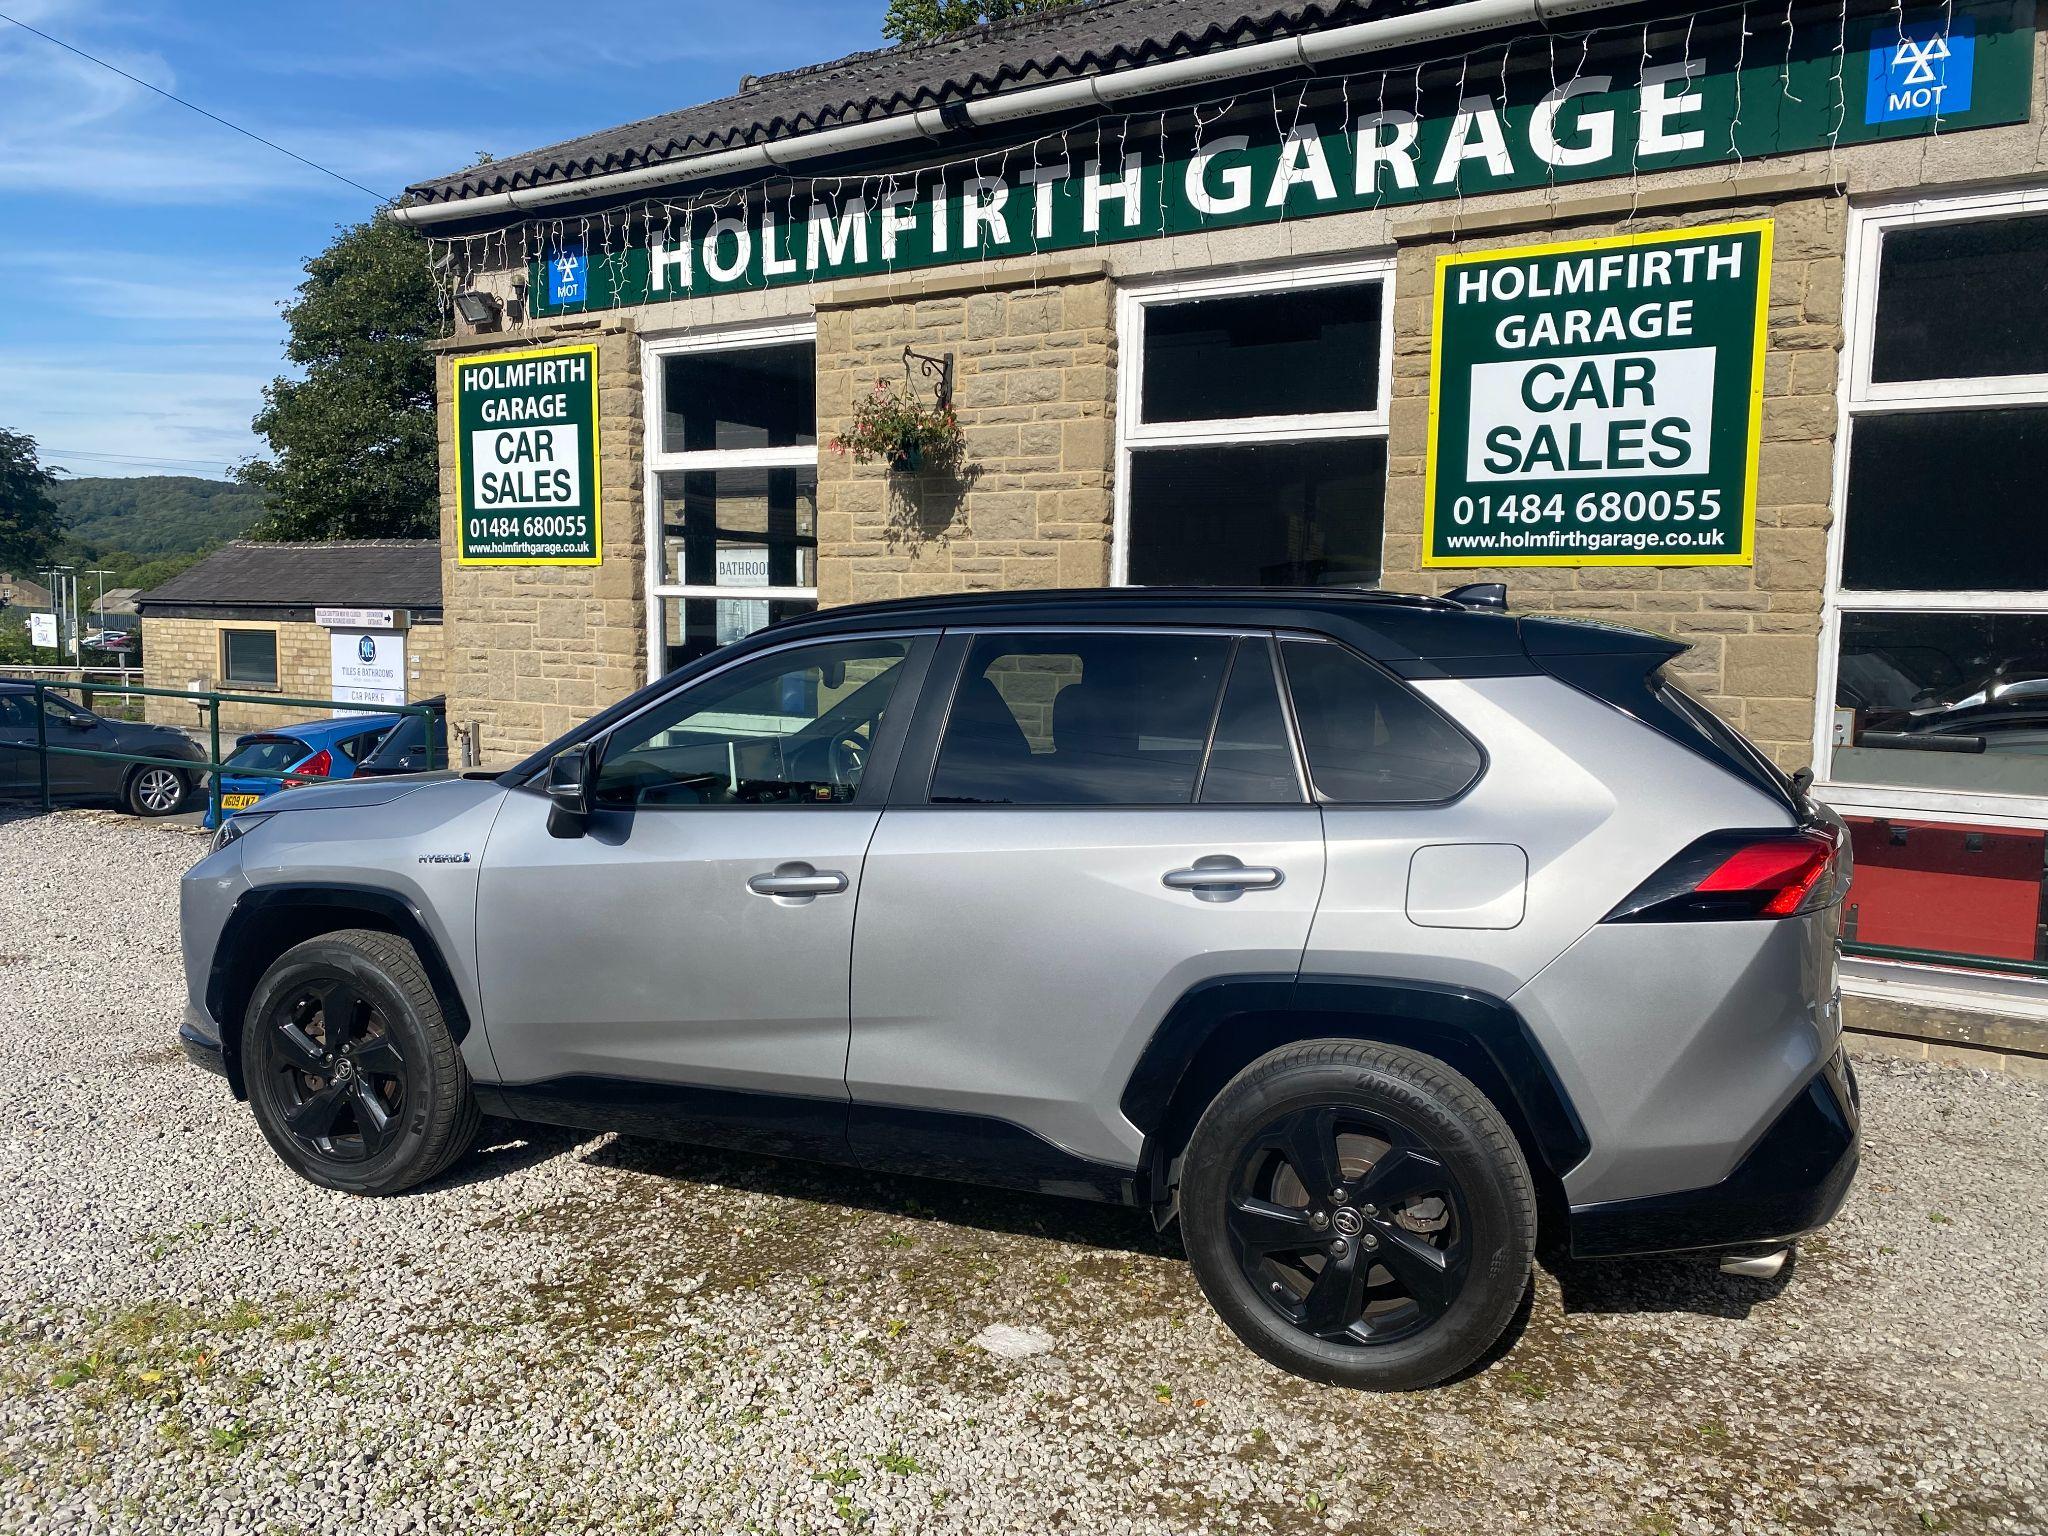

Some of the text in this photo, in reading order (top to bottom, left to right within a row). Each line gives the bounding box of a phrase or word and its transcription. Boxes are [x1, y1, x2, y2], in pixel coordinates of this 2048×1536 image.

[1889, 85, 1948, 112] MOT
[651, 58, 1707, 291] HOLMFIRTH GARAGE
[1458, 242, 1743, 304] HOLMFIRTH
[557, 283, 579, 298] MOT
[1495, 300, 1693, 349] GARAGE
[464, 358, 586, 391] HOLMFIRTH
[1521, 357, 1657, 413] CAR
[481, 393, 567, 422] GARAGE
[494, 429, 554, 465] CAR
[1483, 416, 1692, 474] SALES
[481, 468, 572, 504] SALES
[1453, 489, 1721, 525] 01484 680055
[470, 515, 587, 537] 01484 680055
[1447, 529, 1724, 550] www.holmfirthgarage.co.uk
[468, 541, 590, 555] www.holmfirthgarage.co.uk
[342, 667, 356, 676] TILES
[362, 668, 394, 678] BATHROOMS
[351, 691, 363, 701] CAR
[364, 692, 379, 702] PARK
